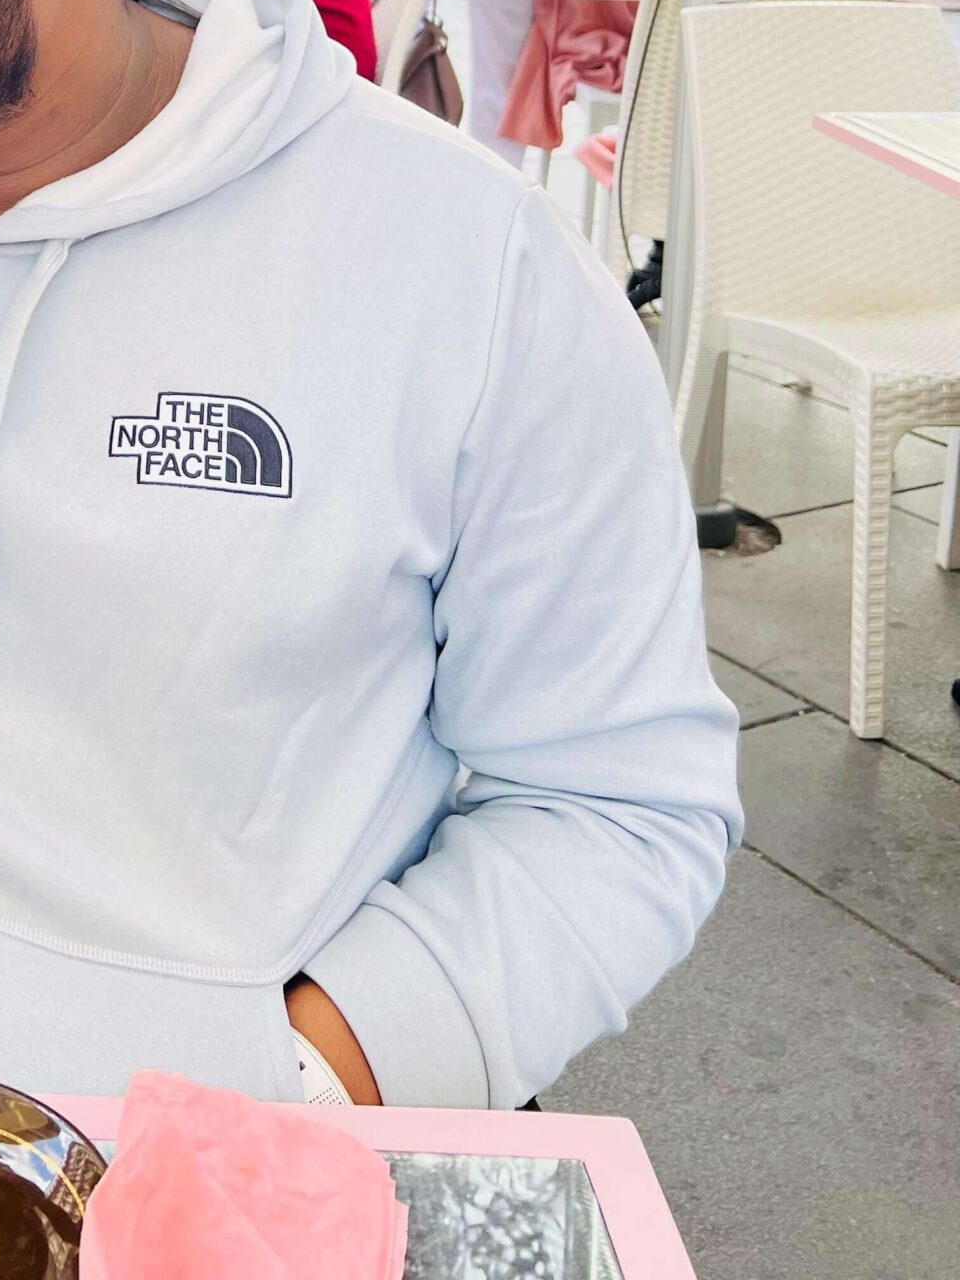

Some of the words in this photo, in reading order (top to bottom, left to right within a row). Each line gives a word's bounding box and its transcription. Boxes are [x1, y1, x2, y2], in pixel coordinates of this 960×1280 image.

[166, 401, 224, 427] THE
[117, 424, 223, 452] NORTH
[145, 451, 223, 480] FACE
